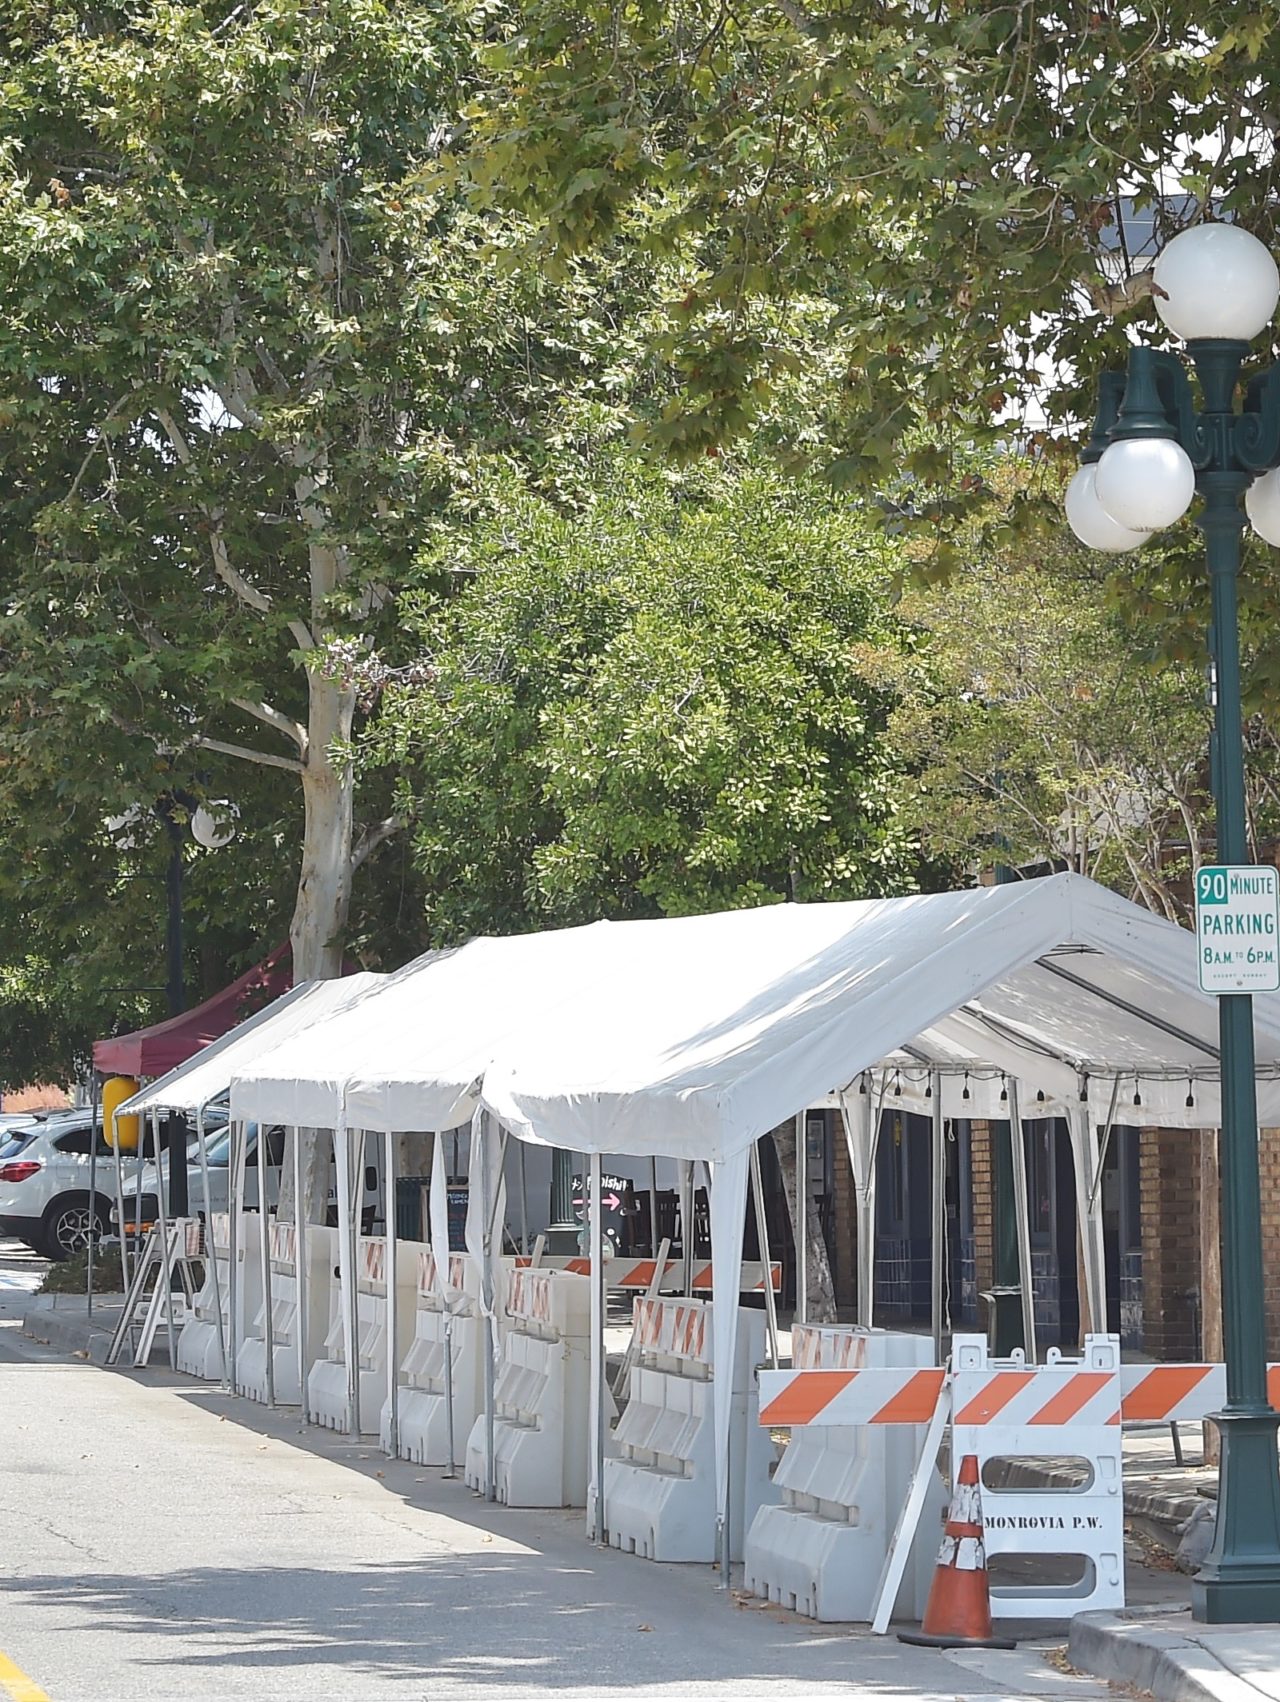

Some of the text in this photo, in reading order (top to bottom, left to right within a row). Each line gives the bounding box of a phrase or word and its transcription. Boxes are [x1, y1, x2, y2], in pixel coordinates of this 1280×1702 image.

[1199, 874, 1274, 900] 90 MINUTE
[1203, 913, 1274, 935] PARKING
[985, 1516, 1103, 1529] MONROVIA P.W.
